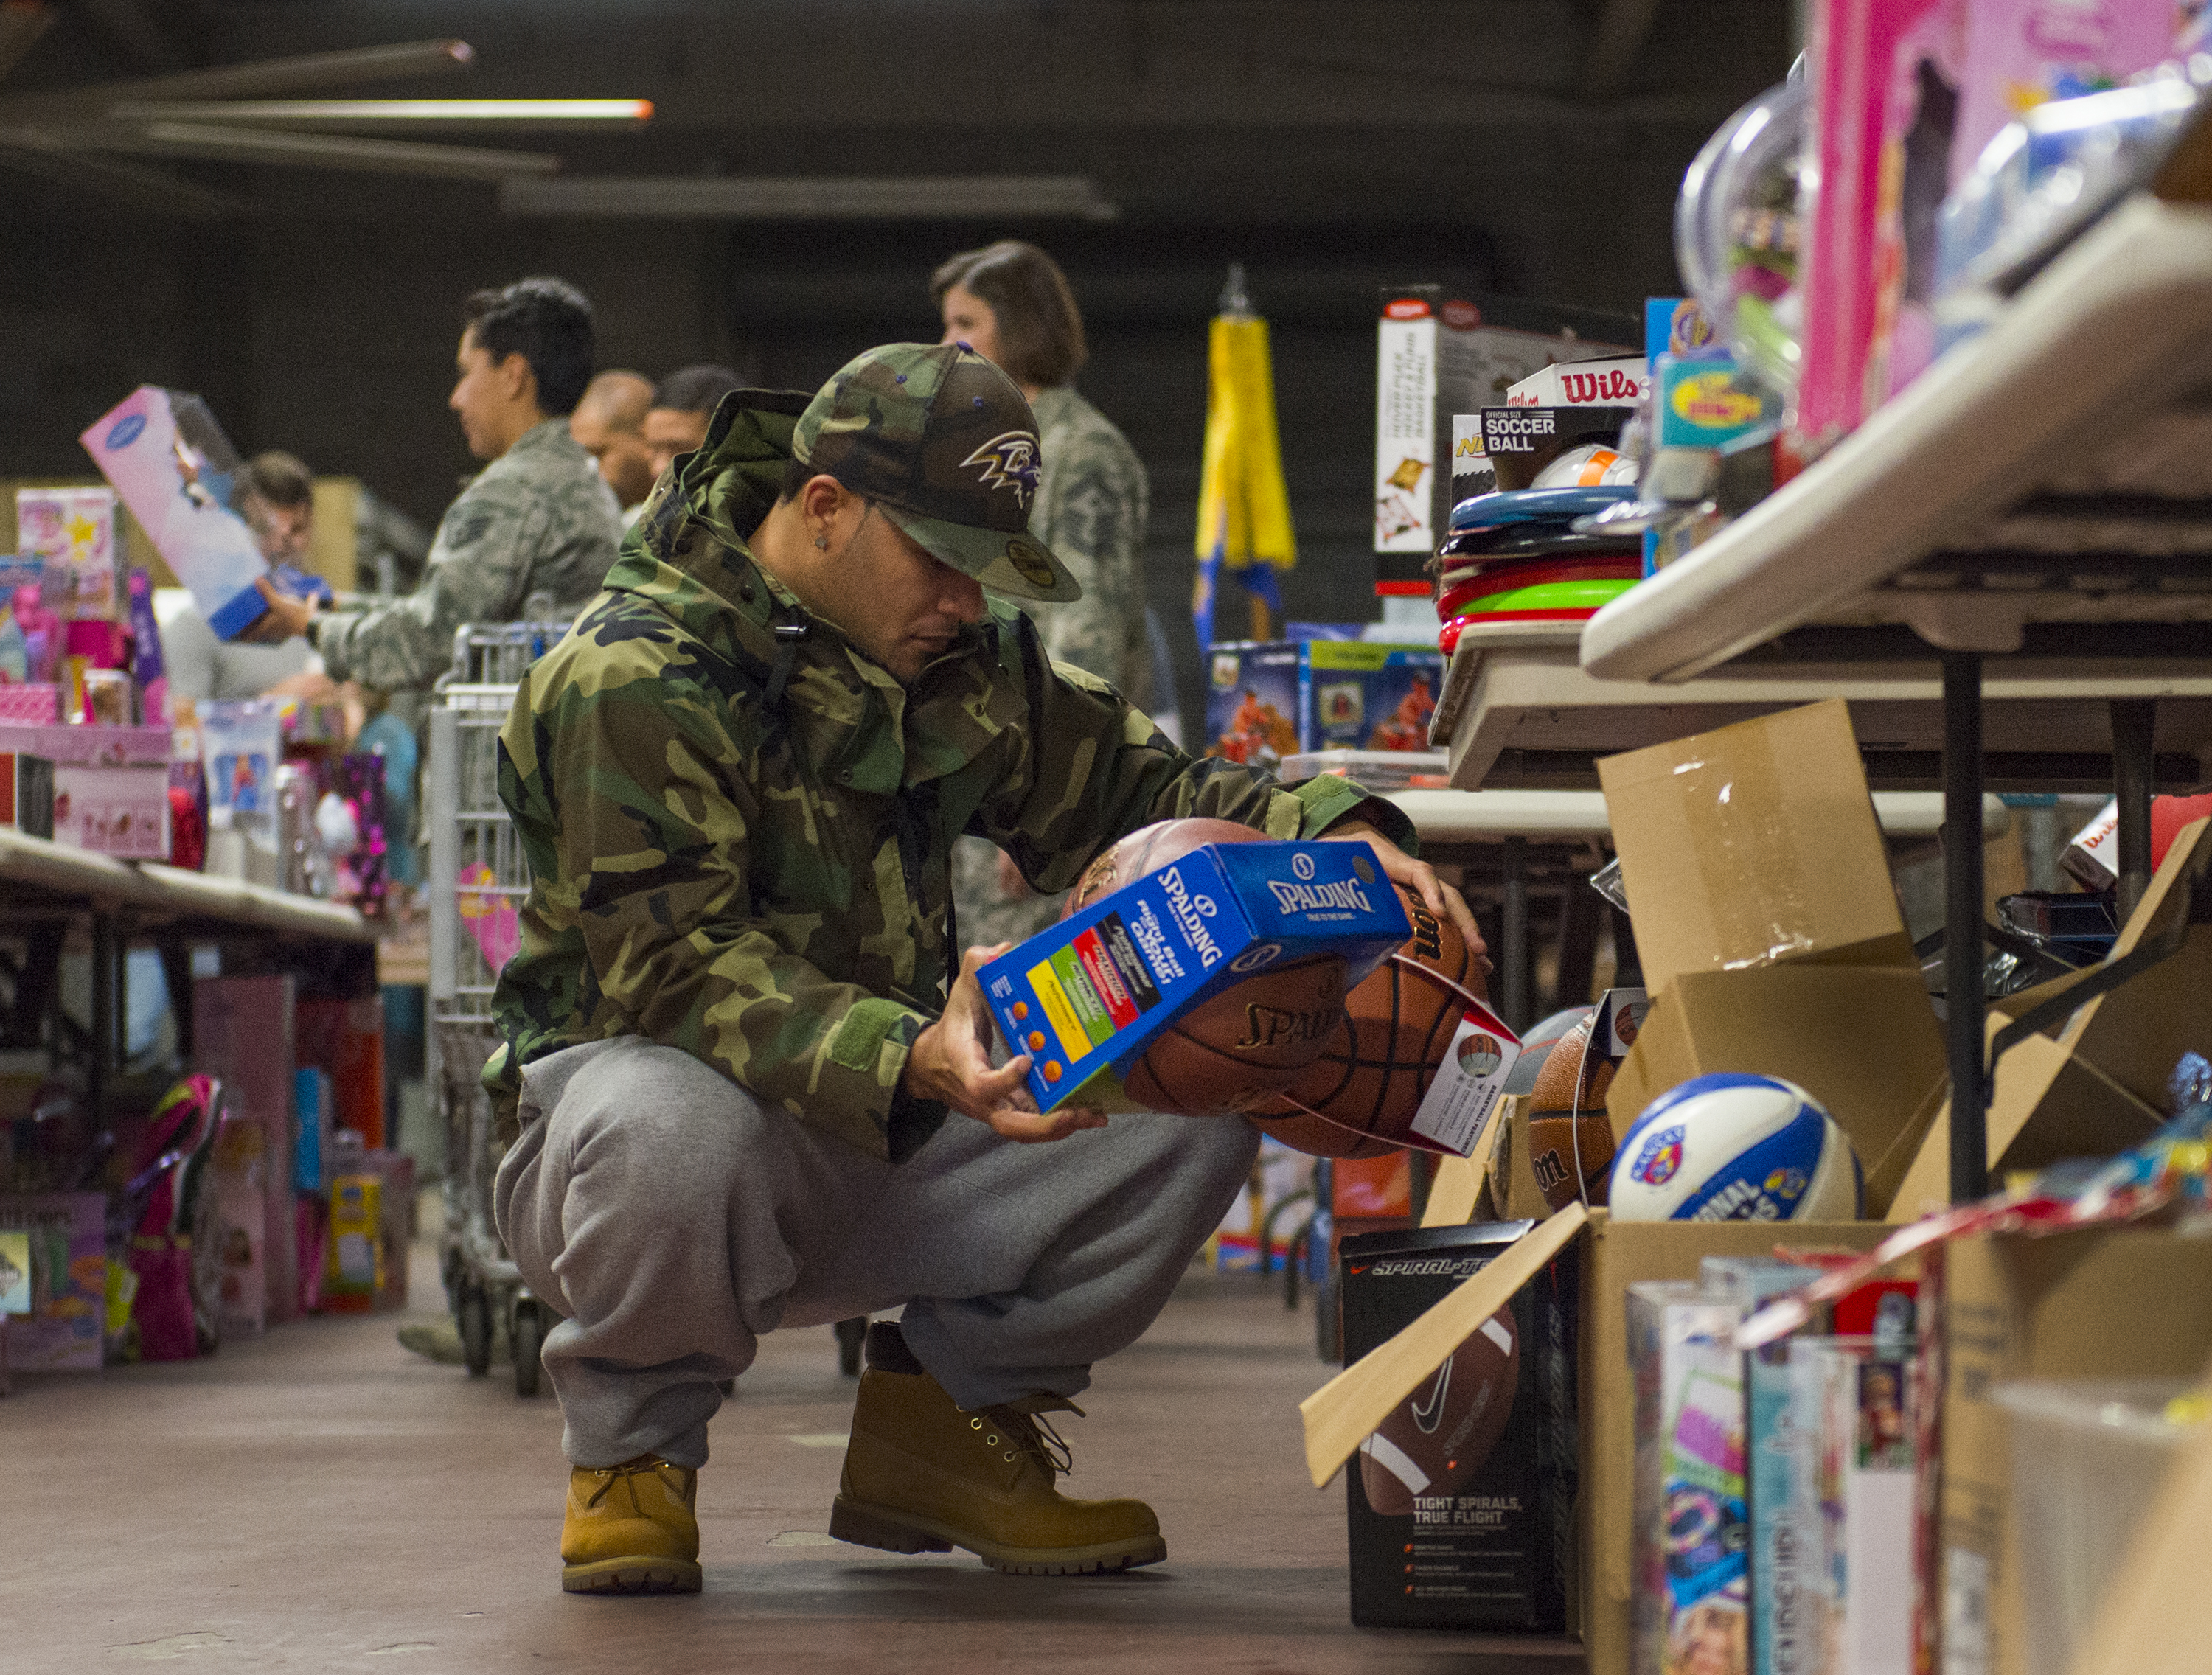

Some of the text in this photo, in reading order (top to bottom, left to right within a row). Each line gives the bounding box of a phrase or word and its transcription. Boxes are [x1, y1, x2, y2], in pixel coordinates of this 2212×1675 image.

[1486, 411, 1509, 419] OFFICIAL
[1486, 419, 1556, 435] SOCCER
[1488, 436, 1534, 452] BALL
[1267, 878, 1373, 916] SPALDING
[1157, 866, 1224, 969] SPALDING
[1130, 921, 1172, 984] Game!
[1136, 899, 1186, 978] Right Ball
[1145, 927, 1176, 979] Your
[1475, 1084, 1498, 1123] BASKETBALL
[1413, 1497, 1523, 1511] TIGHT SPIRALS,
[1413, 1511, 1503, 1525] TRUE FLIGHT
